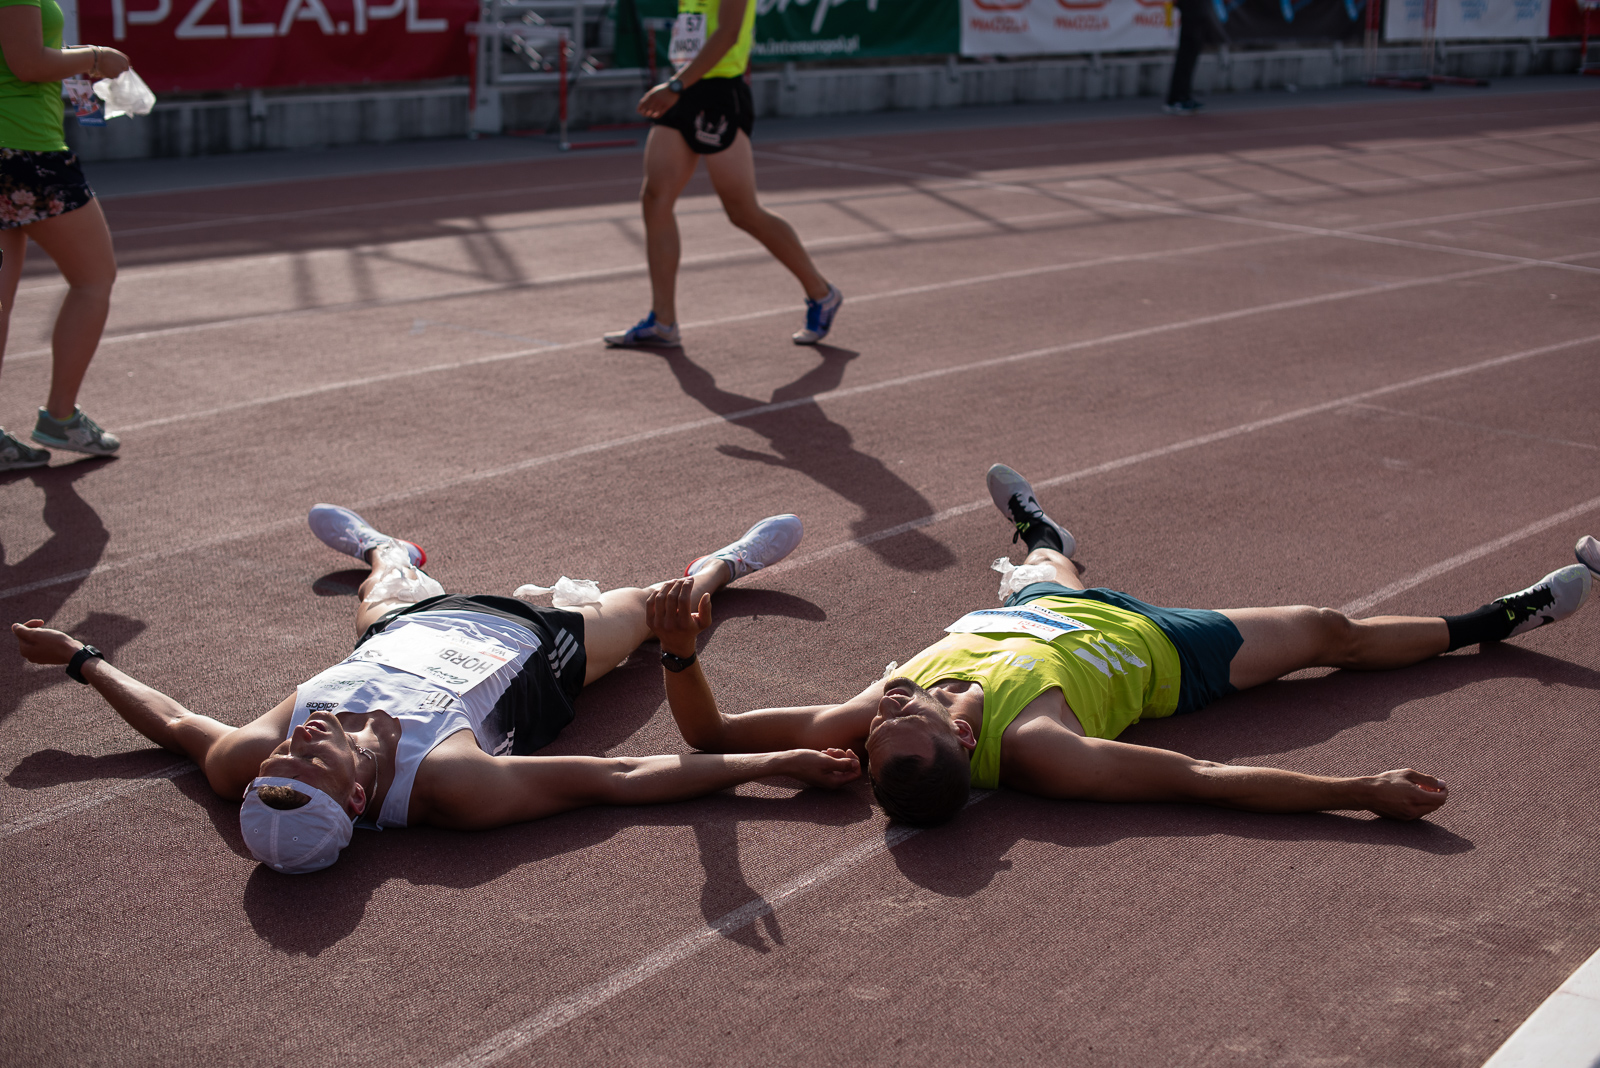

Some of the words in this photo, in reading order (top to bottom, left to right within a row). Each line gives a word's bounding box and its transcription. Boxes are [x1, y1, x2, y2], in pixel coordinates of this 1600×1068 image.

[112, 0, 449, 40] PZLA.PL
[753, 35, 858, 55] w.intereuropol.pl
[435, 647, 495, 676] HORB
[305, 701, 339, 711] adidas
